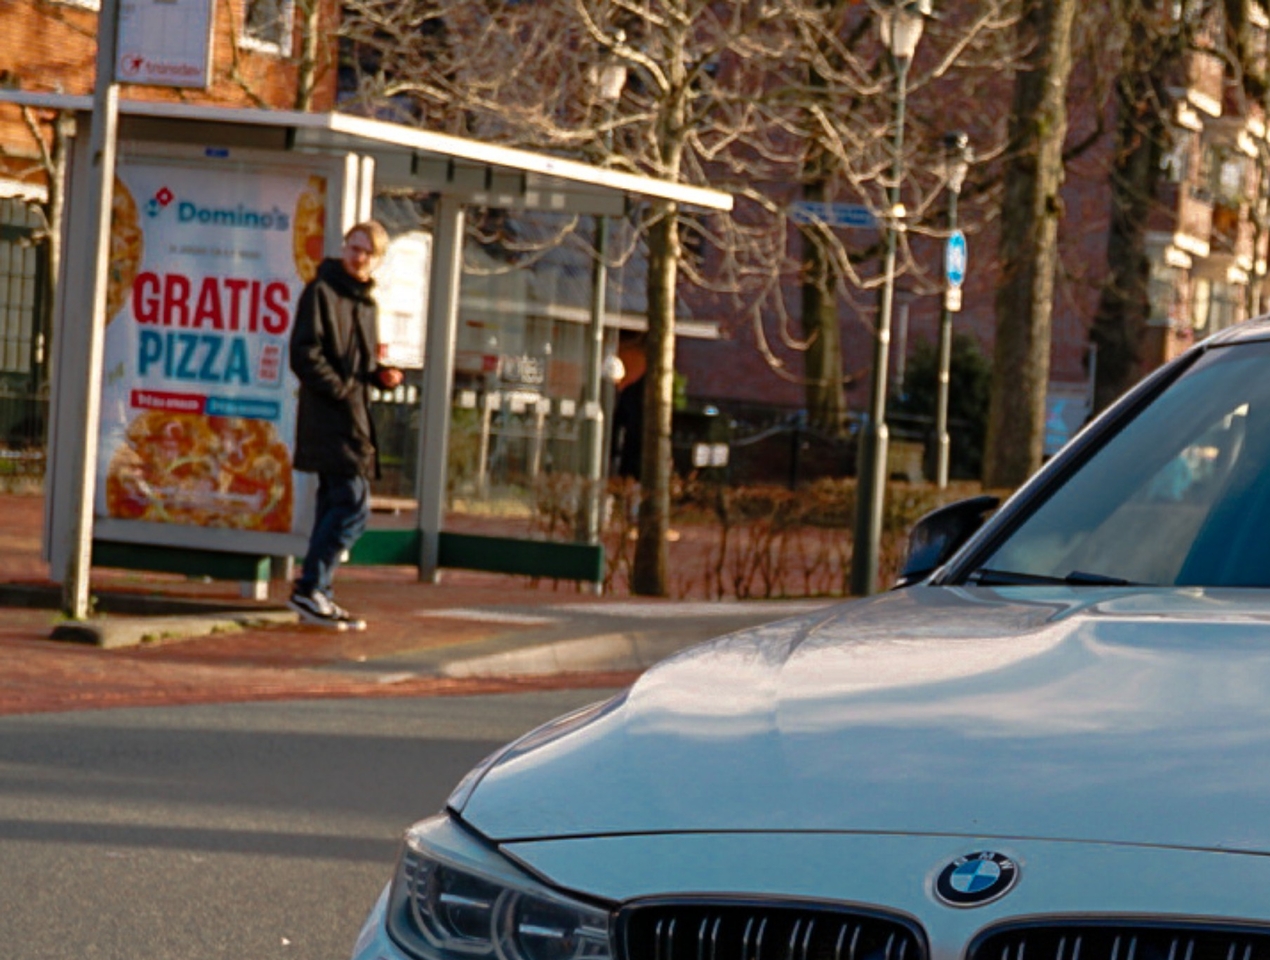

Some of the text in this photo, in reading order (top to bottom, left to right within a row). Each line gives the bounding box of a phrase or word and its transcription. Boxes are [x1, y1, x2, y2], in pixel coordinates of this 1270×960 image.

[178, 202, 289, 231] Domino's
[133, 271, 290, 335] GRATIS
[138, 330, 250, 384] PIZZA
